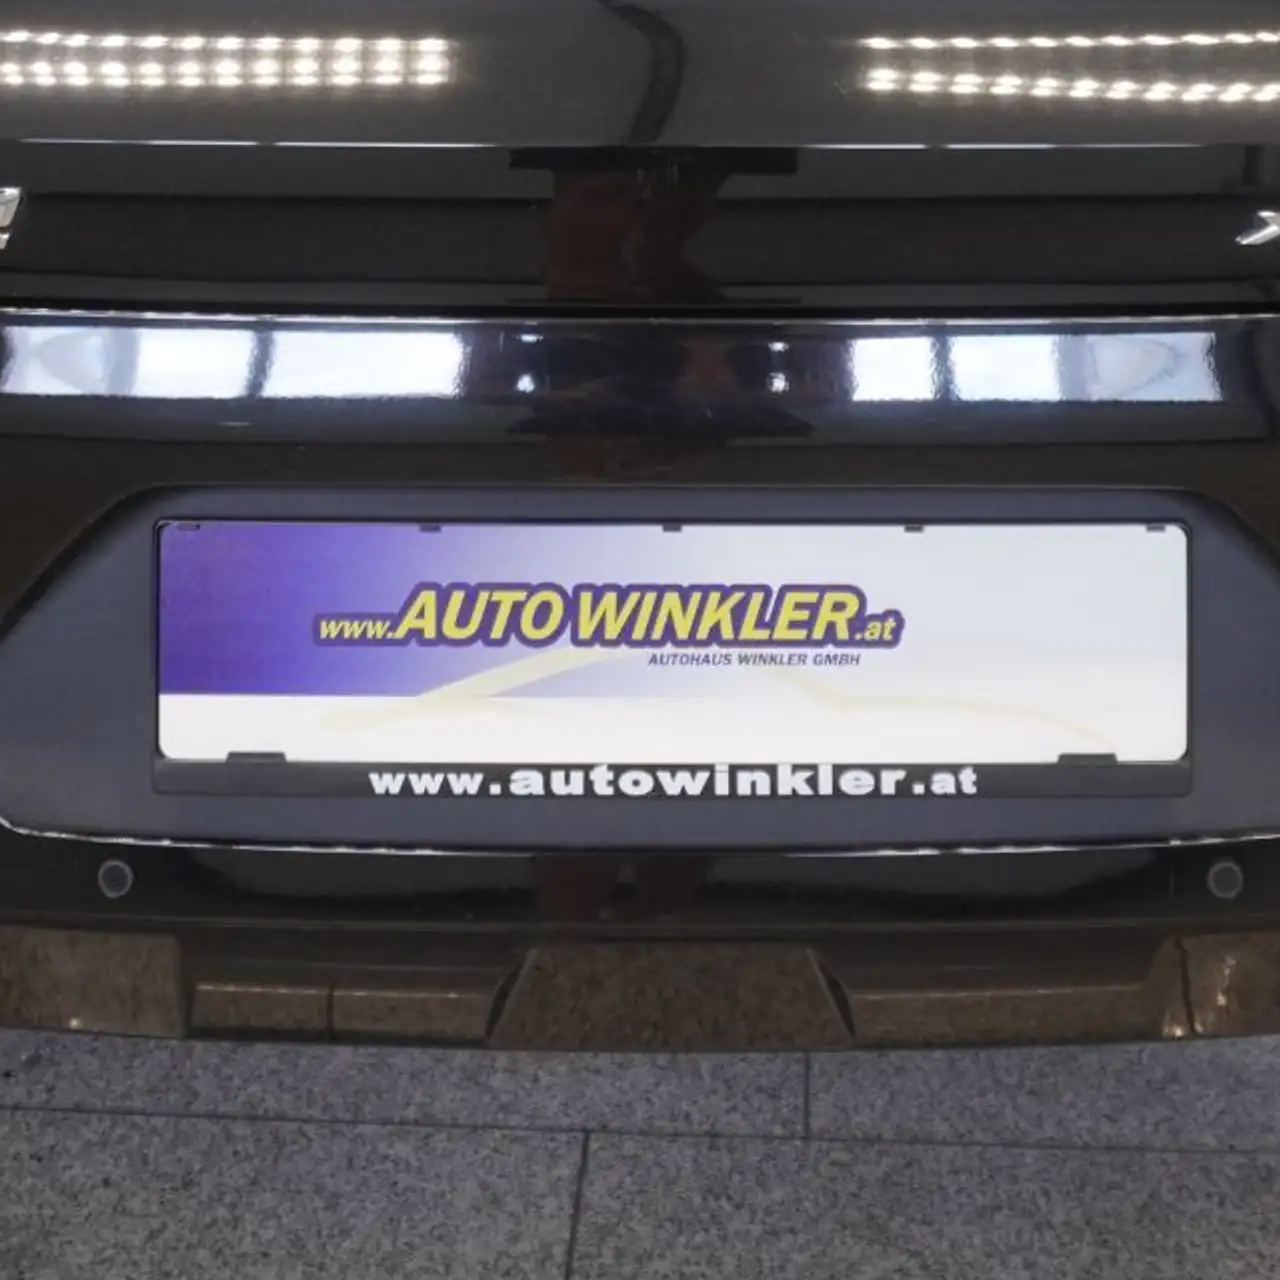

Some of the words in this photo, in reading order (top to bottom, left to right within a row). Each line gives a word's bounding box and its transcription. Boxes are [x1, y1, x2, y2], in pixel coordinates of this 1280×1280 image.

[648, 652, 732, 666] AUTOHAUS
[737, 653, 808, 667] WINKLER
[812, 653, 861, 667] GMBH
[368, 762, 978, 797] www.autowinkler.at
